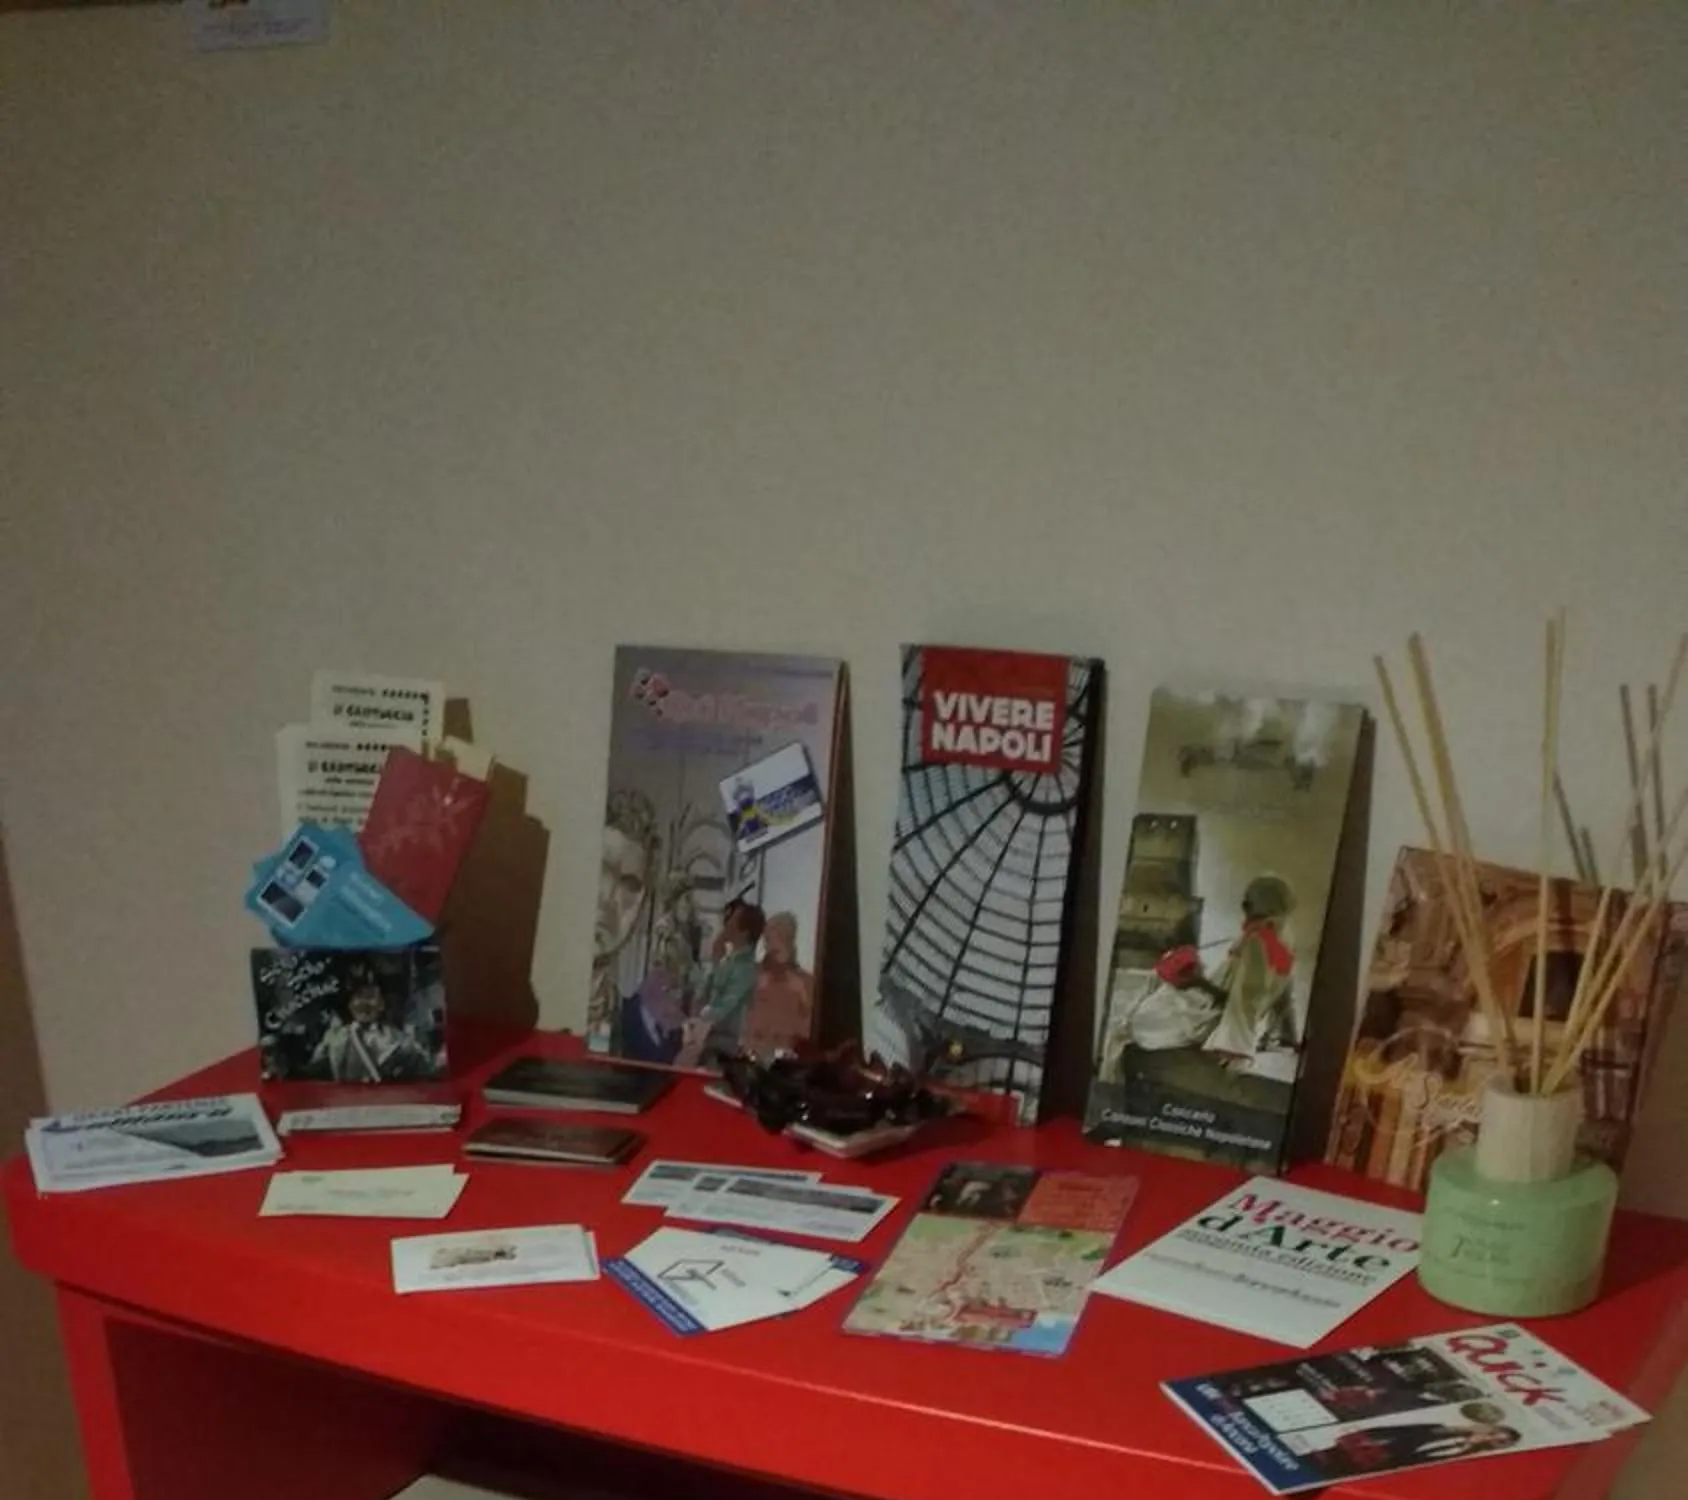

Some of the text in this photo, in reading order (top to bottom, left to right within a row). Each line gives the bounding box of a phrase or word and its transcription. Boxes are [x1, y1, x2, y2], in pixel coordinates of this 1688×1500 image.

[933, 690, 1056, 730] VIVERE
[931, 722, 1053, 763] NAPOLI
[1229, 1193, 1421, 1252] Maggio
